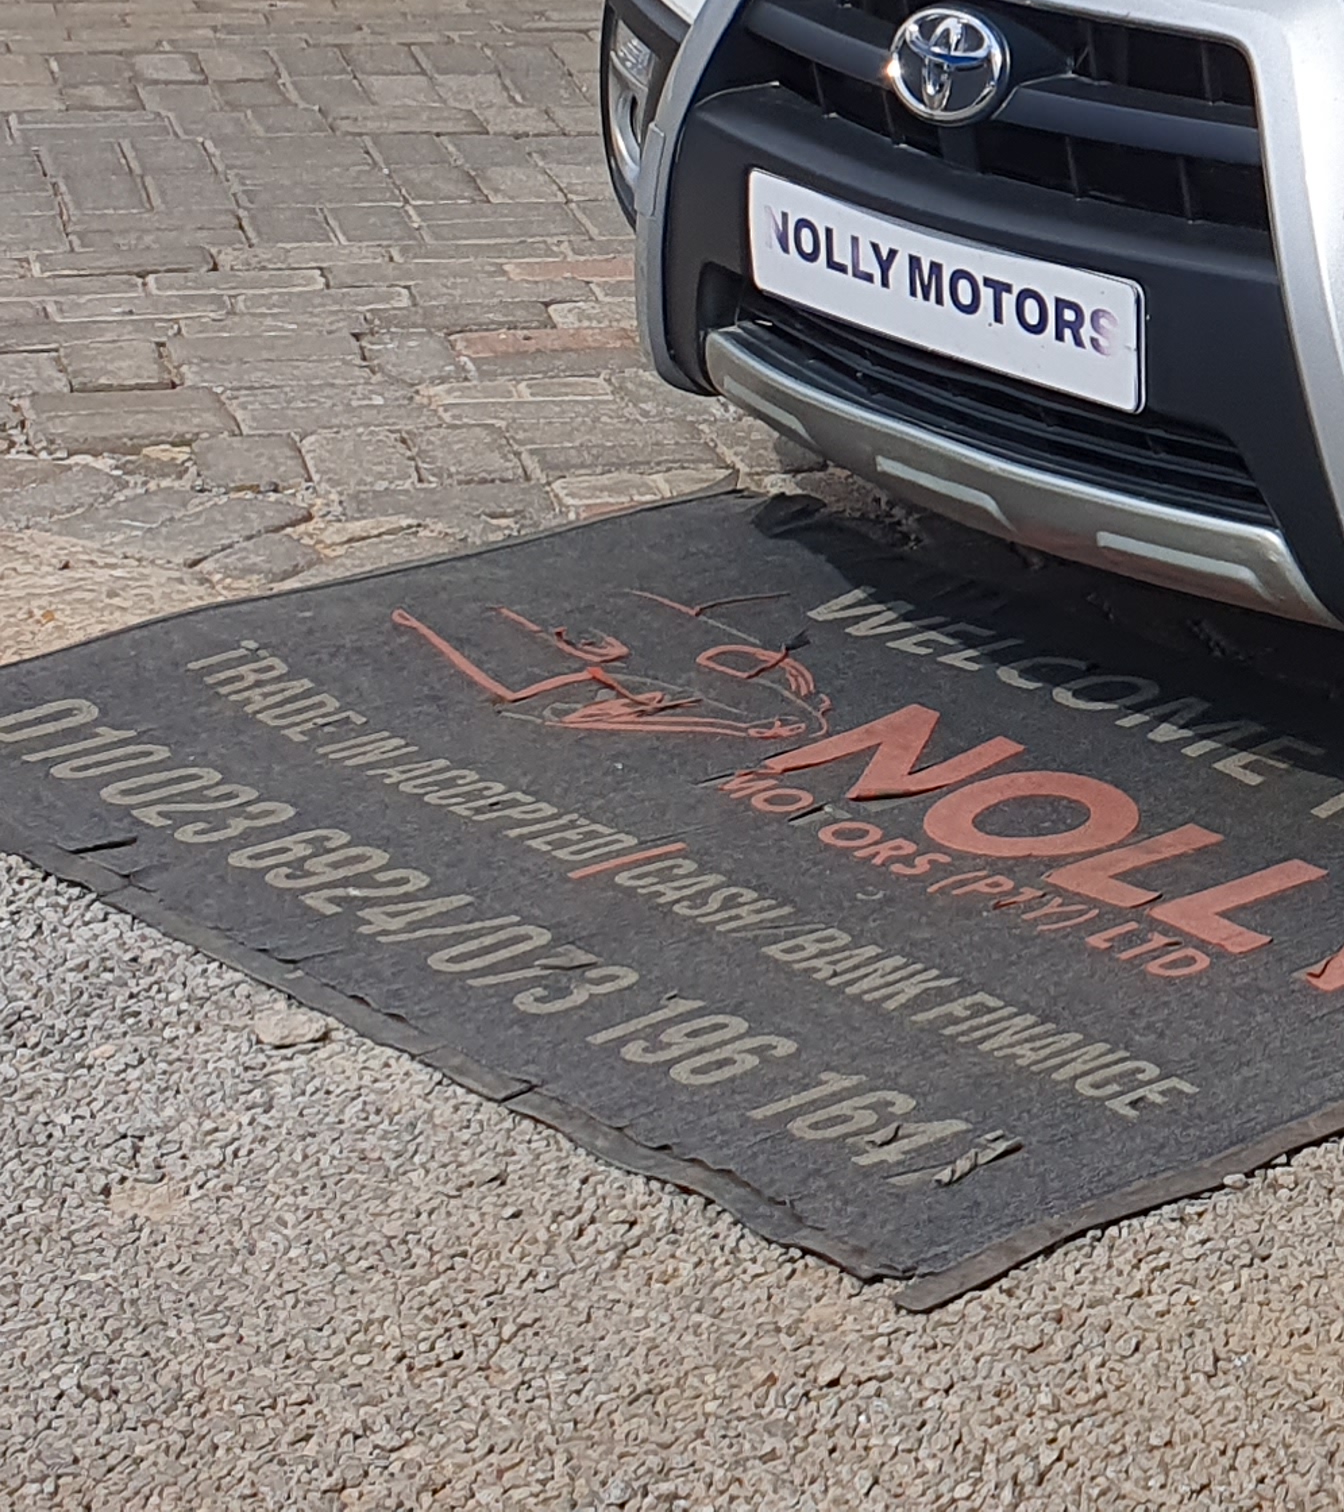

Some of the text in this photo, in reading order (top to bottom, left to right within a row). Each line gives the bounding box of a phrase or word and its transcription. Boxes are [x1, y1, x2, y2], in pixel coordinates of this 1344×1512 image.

[765, 204, 1118, 357] NOLLY MOTORS
[806, 585, 1325, 786] WELCOME
[186, 639, 367, 743] TRADE
[315, 731, 419, 767] IN
[909, 991, 1201, 1119] FINANCE
[1083, 920, 1211, 977] LTD
[585, 990, 799, 1086] 196
